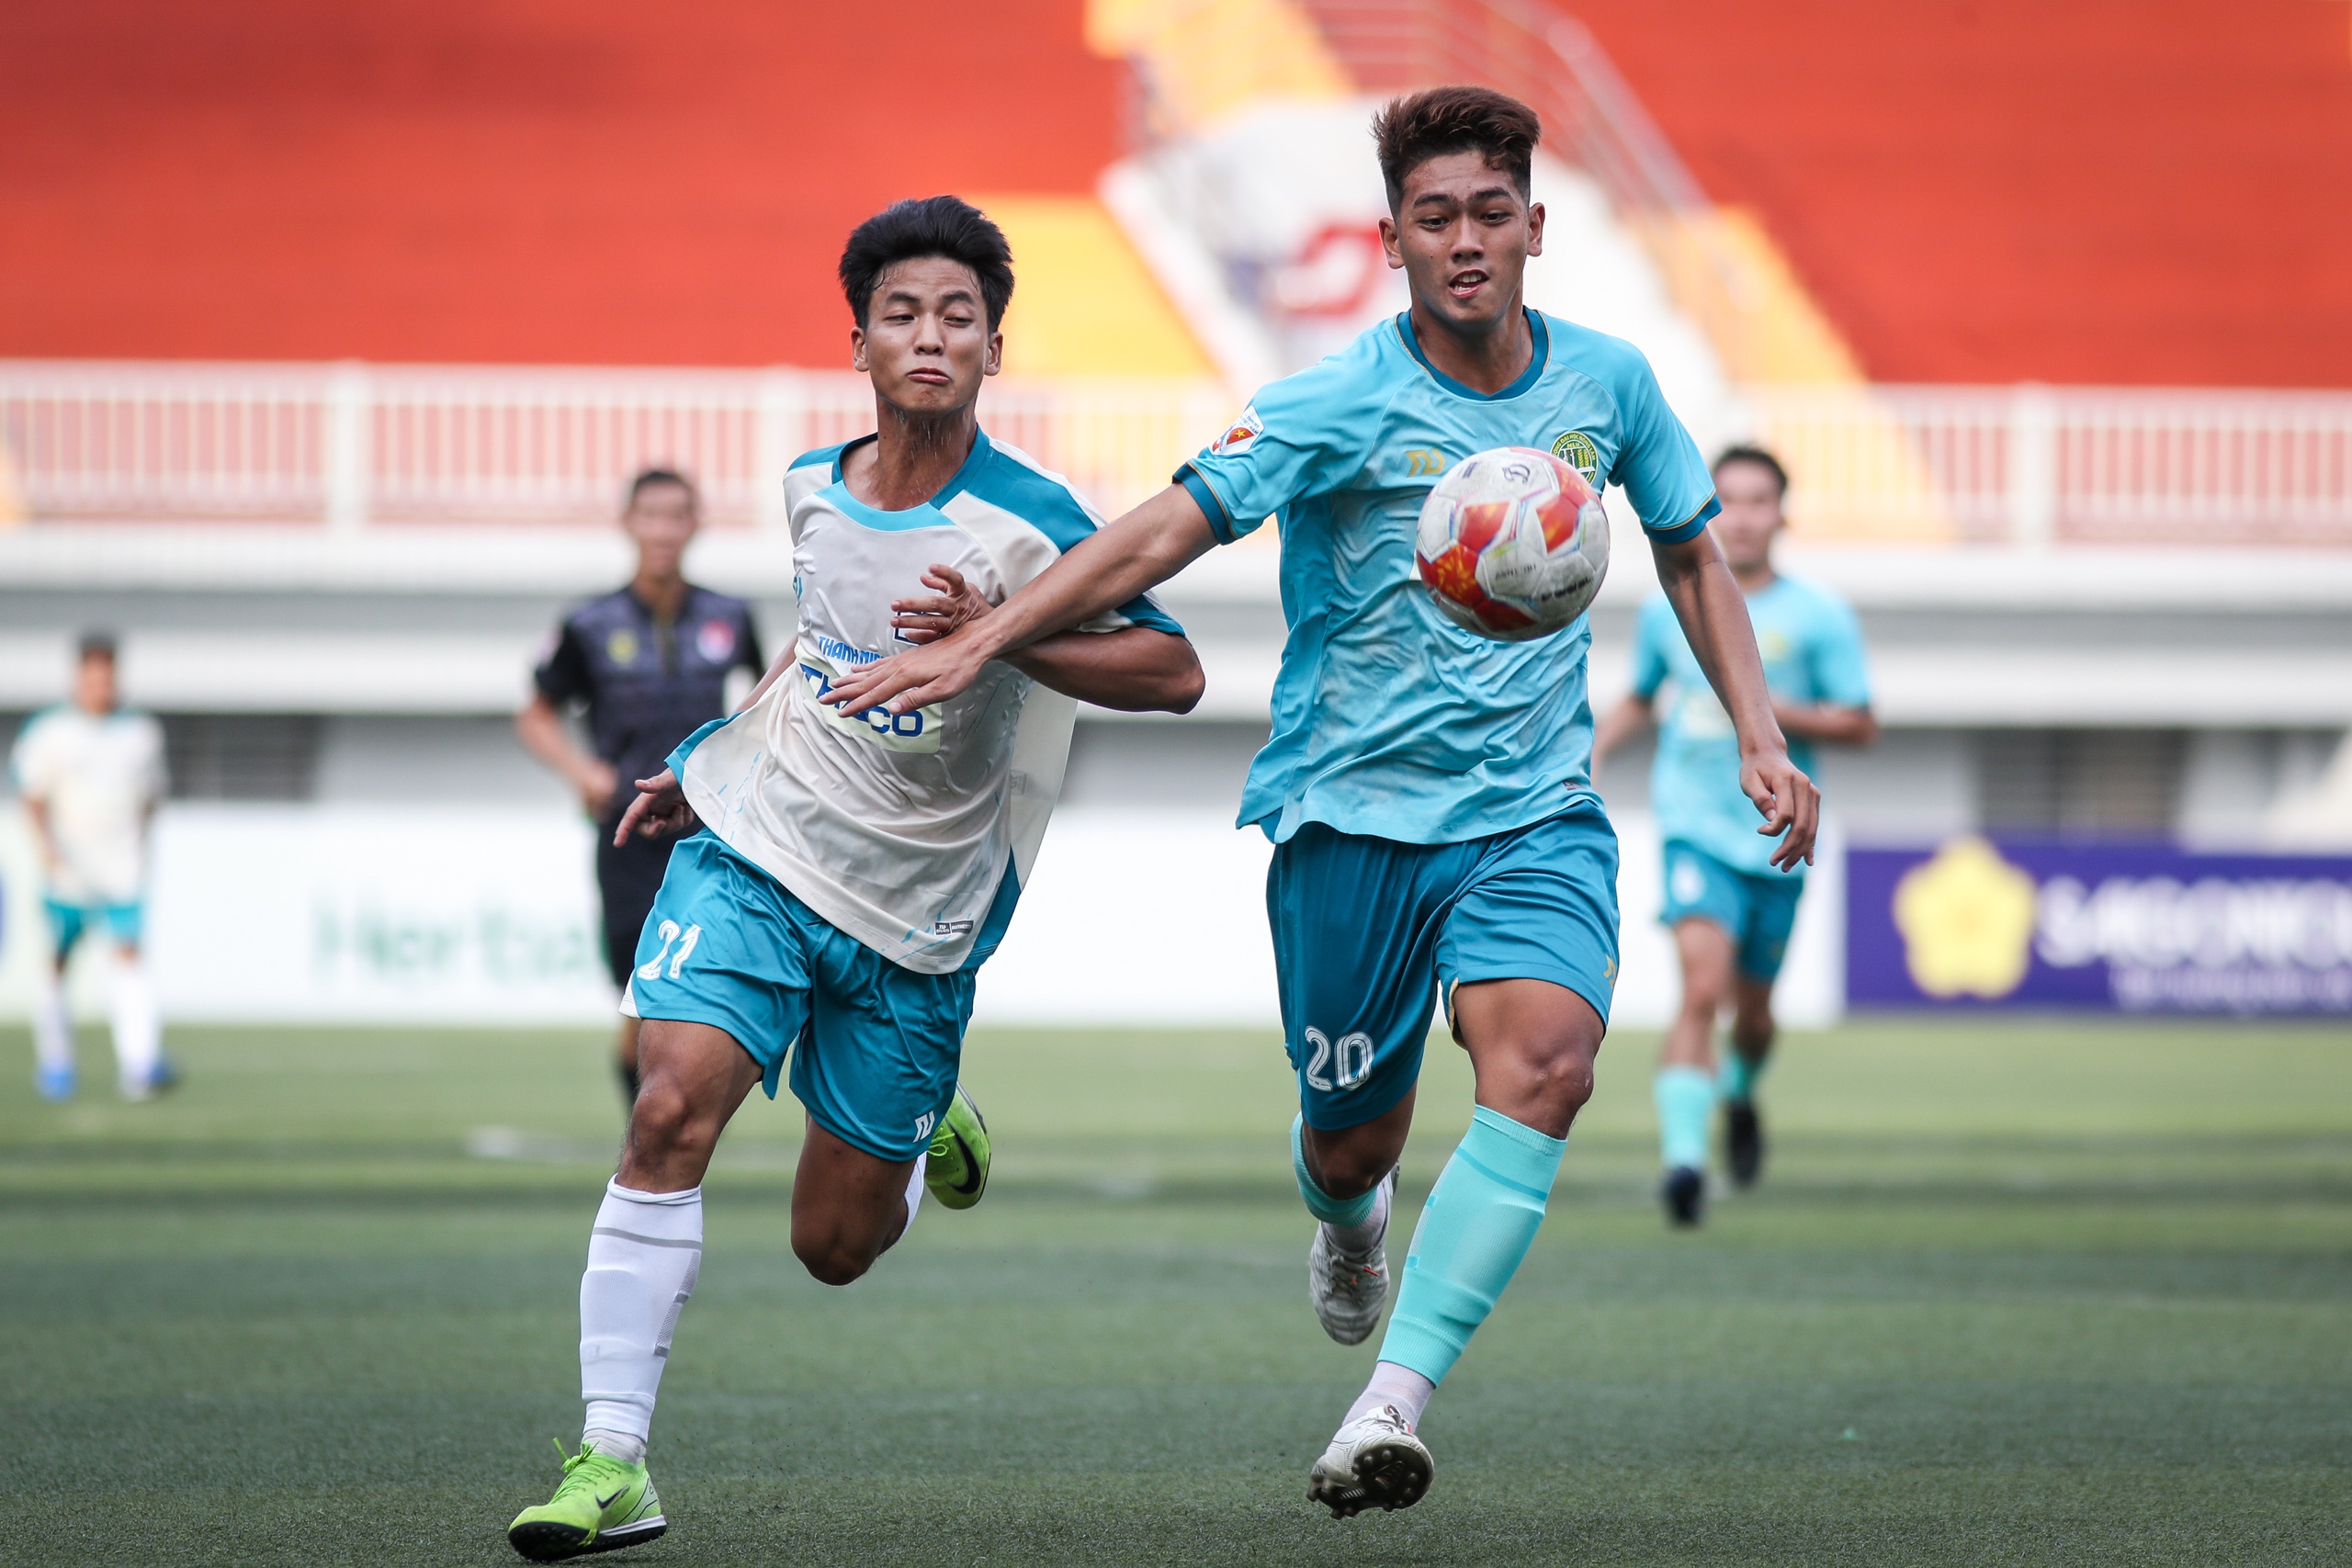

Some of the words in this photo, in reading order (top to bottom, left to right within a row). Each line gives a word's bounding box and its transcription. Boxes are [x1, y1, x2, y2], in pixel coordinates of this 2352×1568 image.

[799, 663, 923, 738] THCO
[637, 919, 704, 981] 21
[1305, 1025, 1374, 1092] 20
